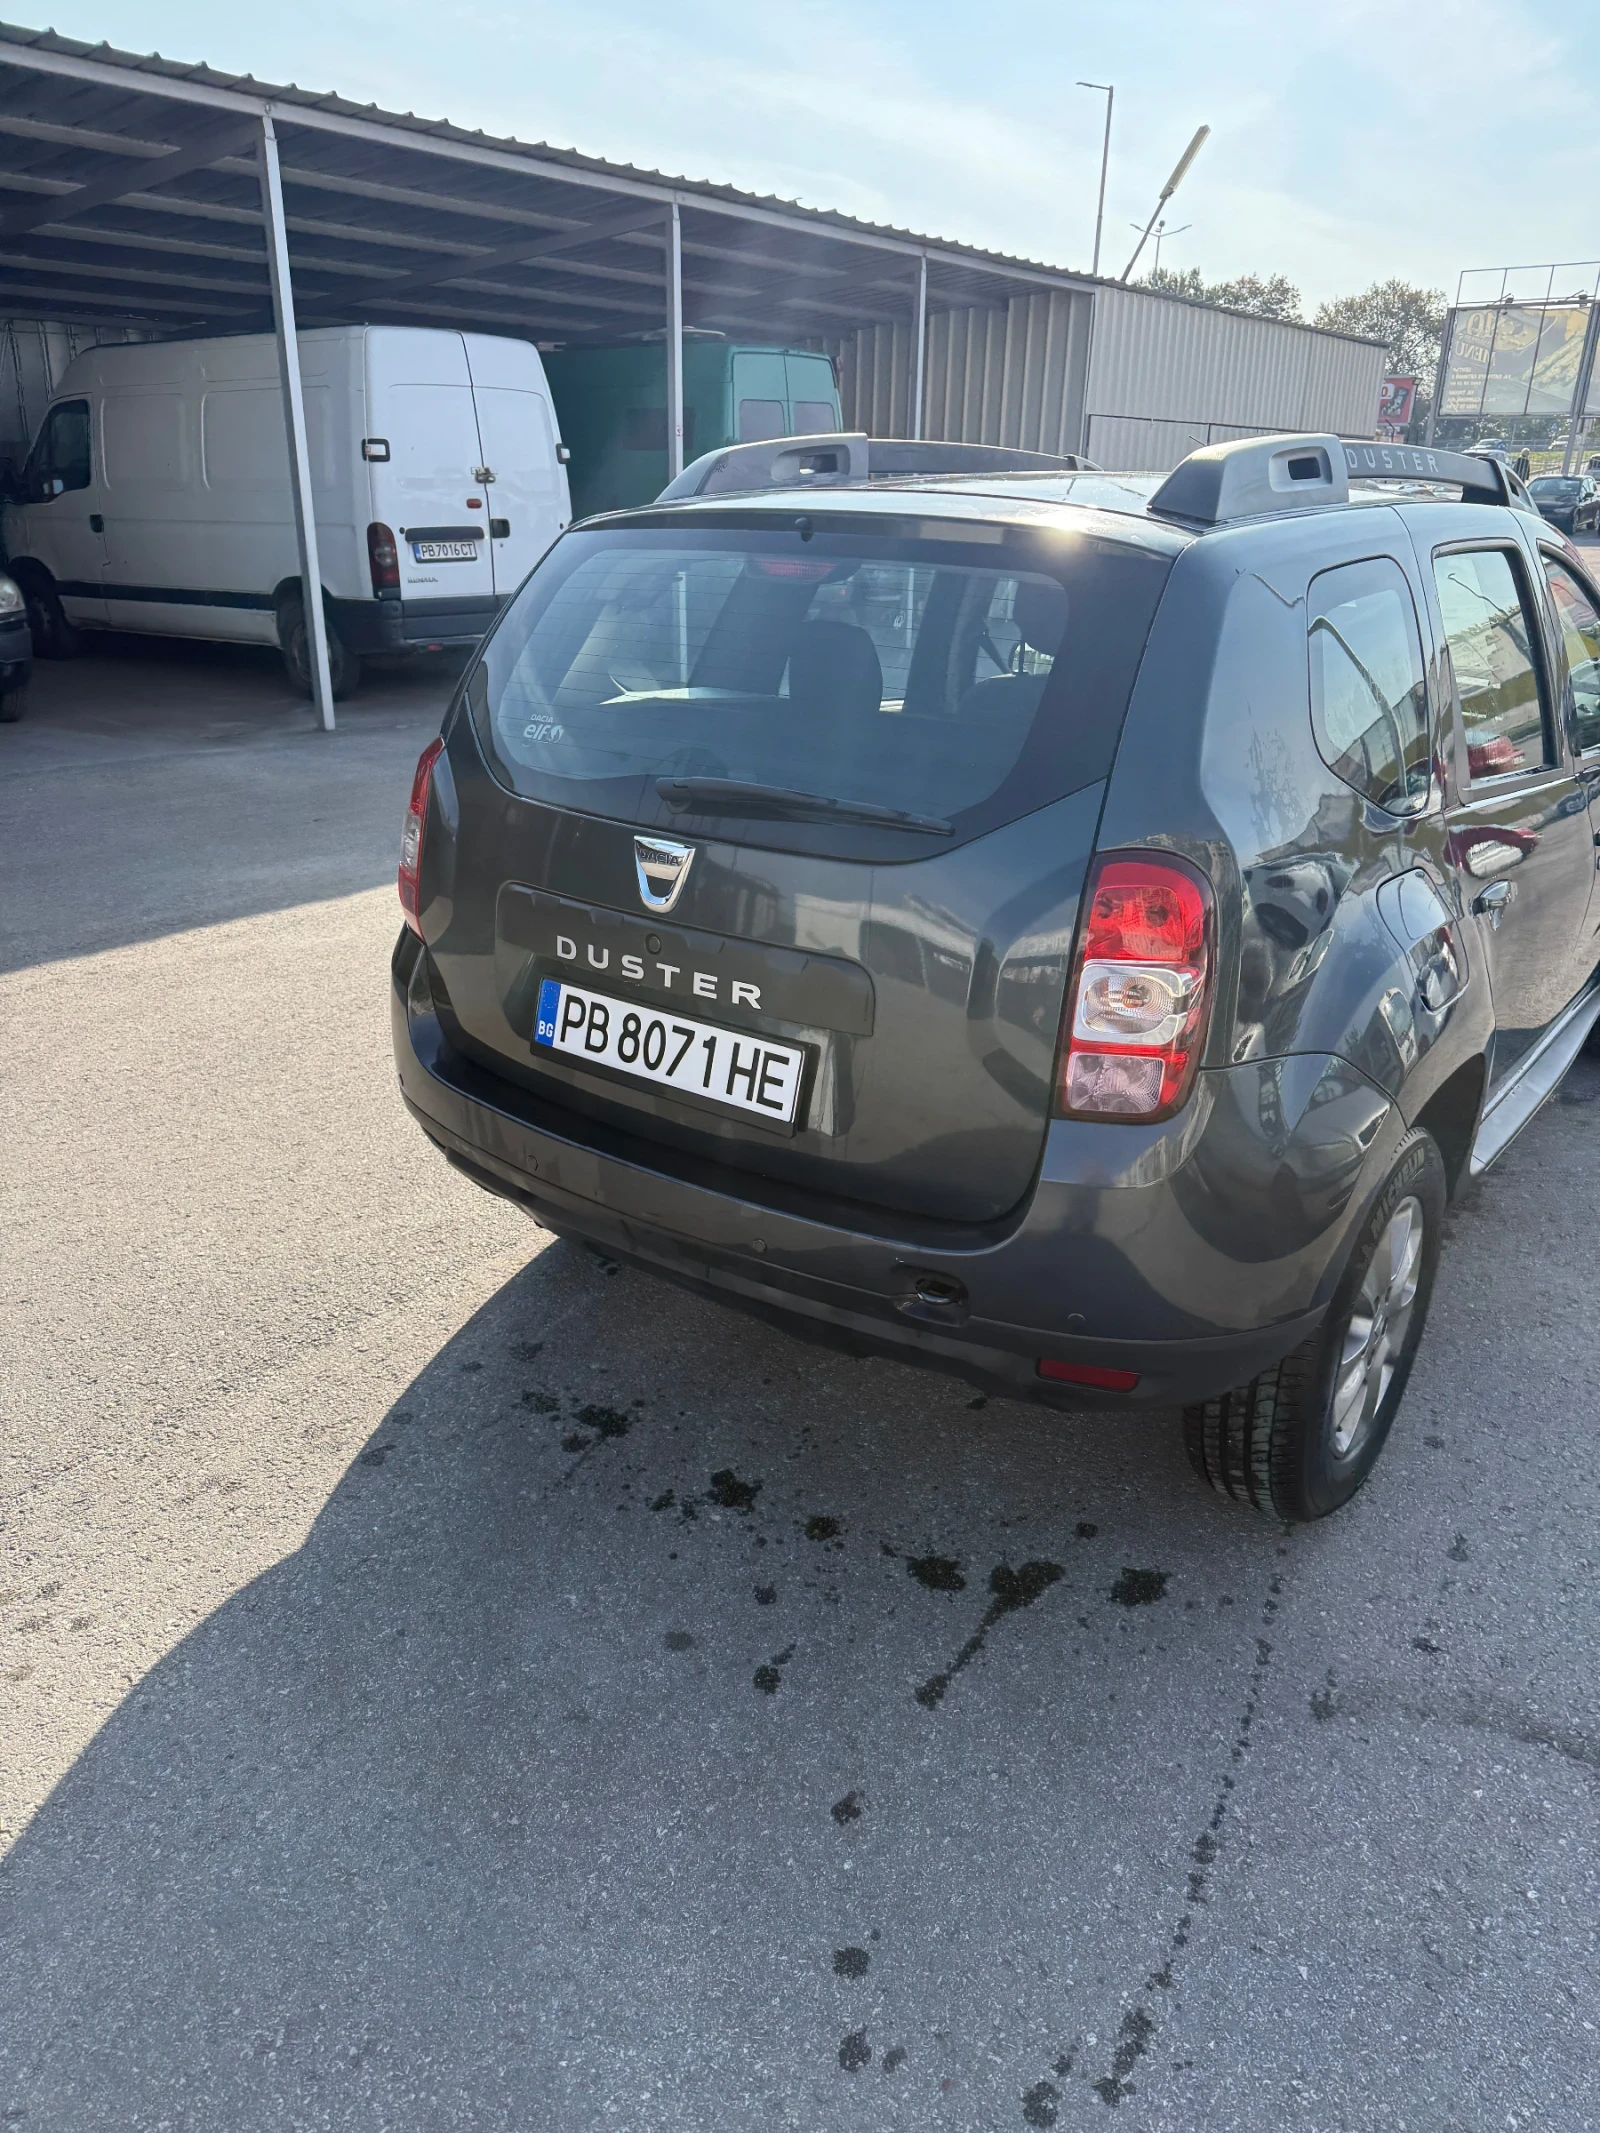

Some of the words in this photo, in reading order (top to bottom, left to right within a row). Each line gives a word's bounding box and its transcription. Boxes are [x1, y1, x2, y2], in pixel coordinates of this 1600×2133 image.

[1345, 448, 1439, 473] DUSTER
[421, 544, 435, 558] PB
[435, 543, 460, 557] 7016
[460, 543, 473, 556] CT
[530, 713, 554, 724] DACIA
[639, 848, 680, 867] DACIA
[556, 935, 762, 1010] DUSTER
[538, 1019, 554, 1039] BG
[560, 993, 610, 1054] PB
[617, 1012, 718, 1089] 8071
[725, 1041, 790, 1122] HE
